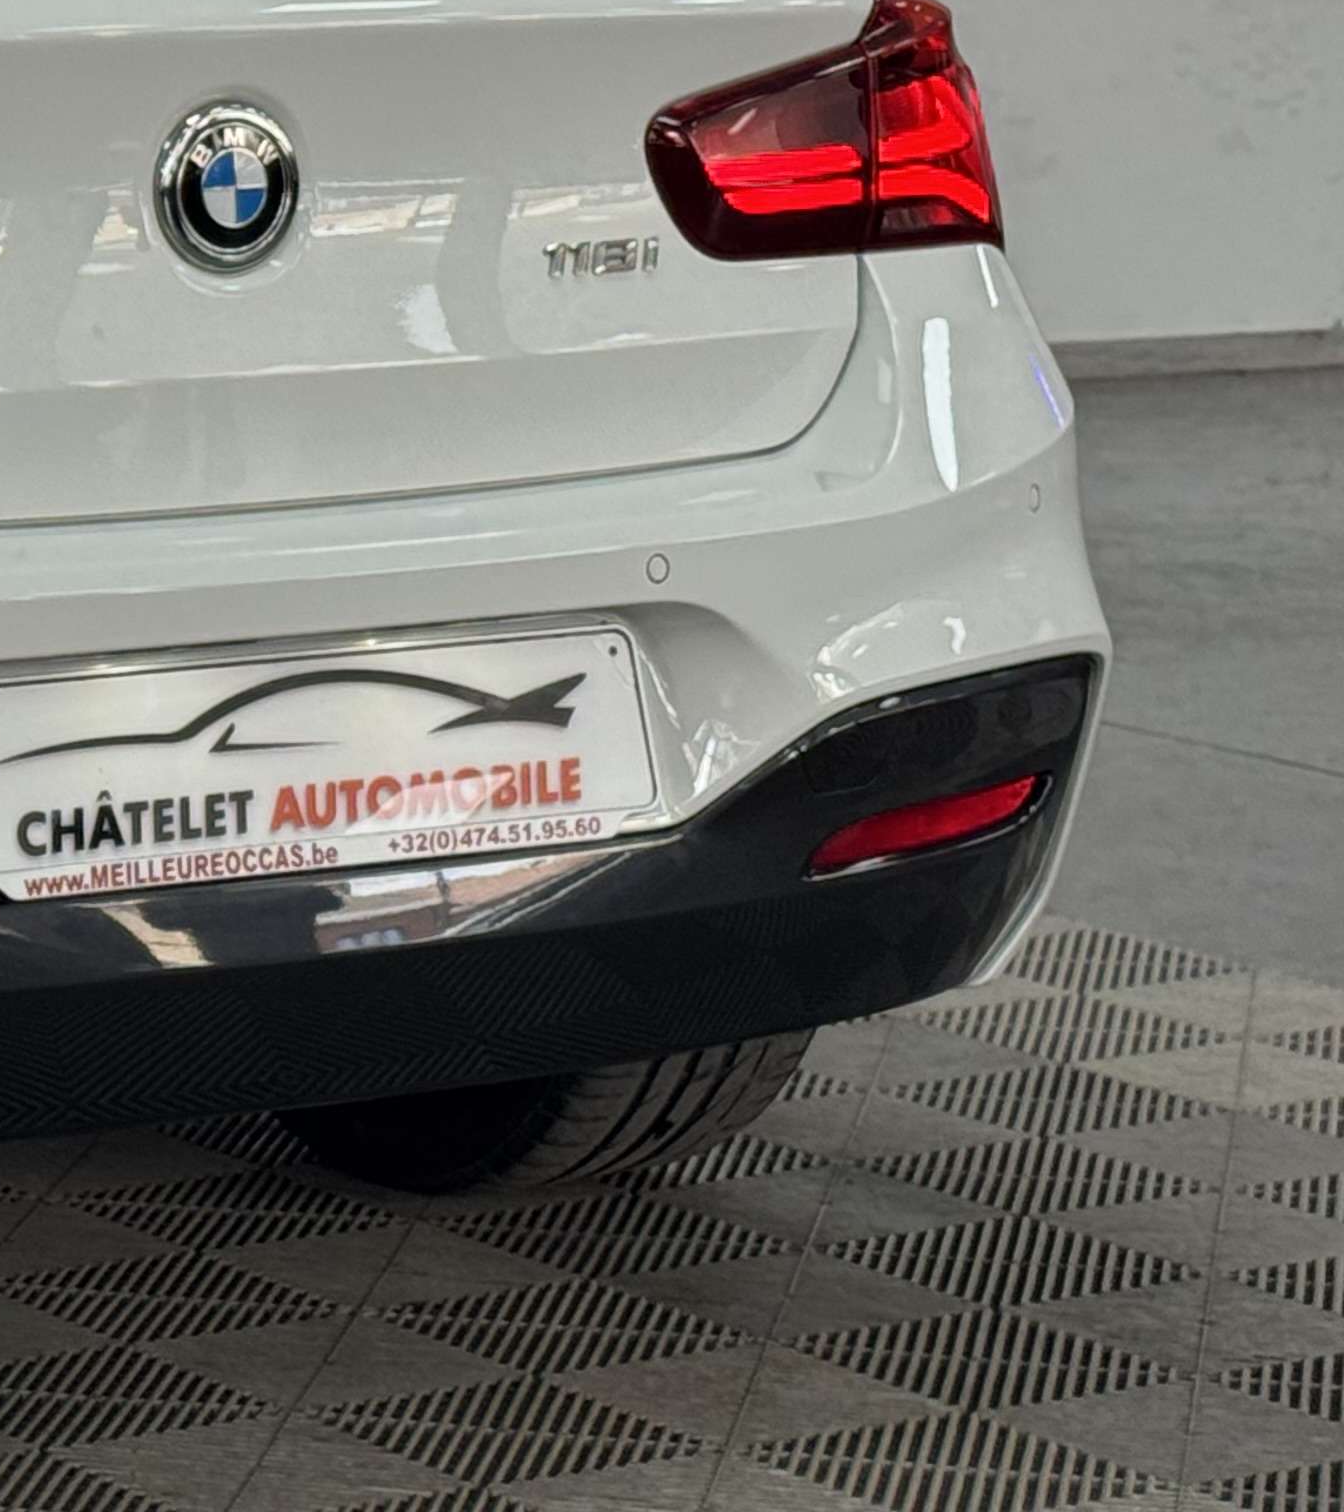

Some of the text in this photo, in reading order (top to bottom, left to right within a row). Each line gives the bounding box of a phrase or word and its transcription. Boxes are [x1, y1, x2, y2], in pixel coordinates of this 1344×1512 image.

[190, 126, 280, 168] BMW
[16, 756, 582, 857] CHÂTELET AUTOMOBILE
[388, 816, 602, 853] +32(0)474.51.95.60
[23, 842, 339, 897] www.MEILLEUREOCCAS.be
